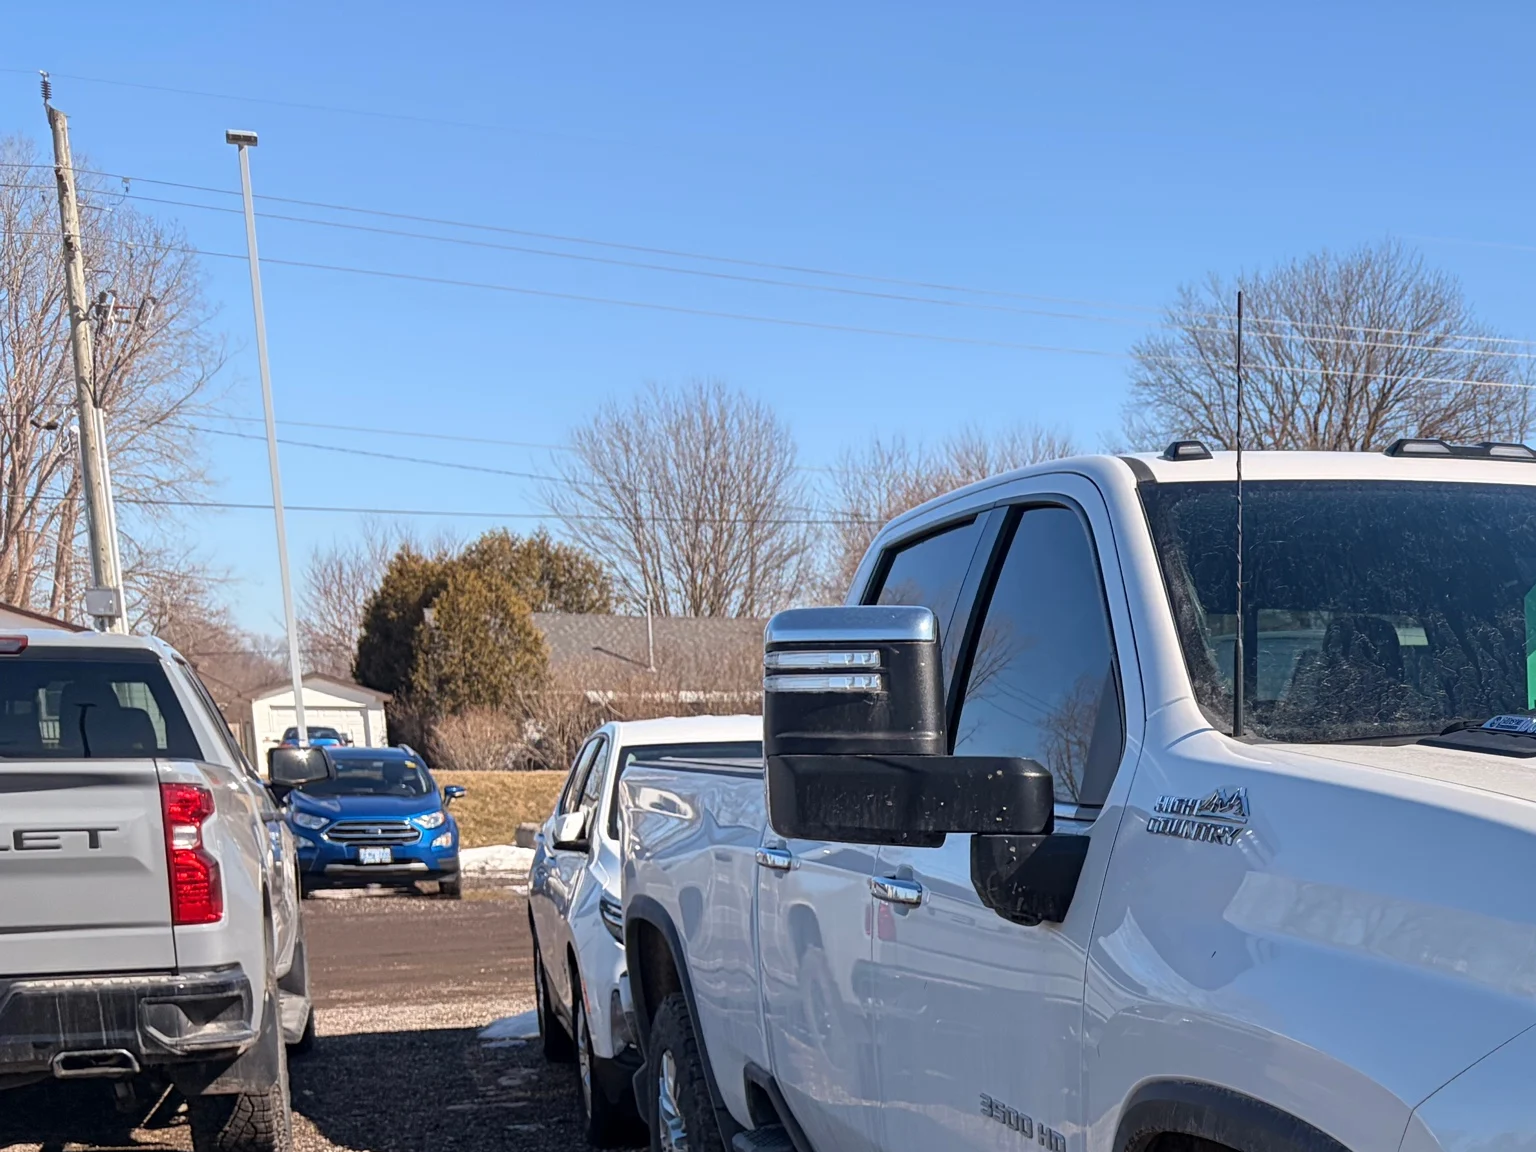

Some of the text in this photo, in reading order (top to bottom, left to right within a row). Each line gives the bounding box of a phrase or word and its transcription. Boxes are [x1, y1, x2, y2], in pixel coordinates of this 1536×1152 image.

[1153, 795, 1202, 816] HIGH
[0, 826, 119, 851] ET
[1146, 816, 1244, 846] COUNTRY
[979, 1092, 1033, 1139] 3500
